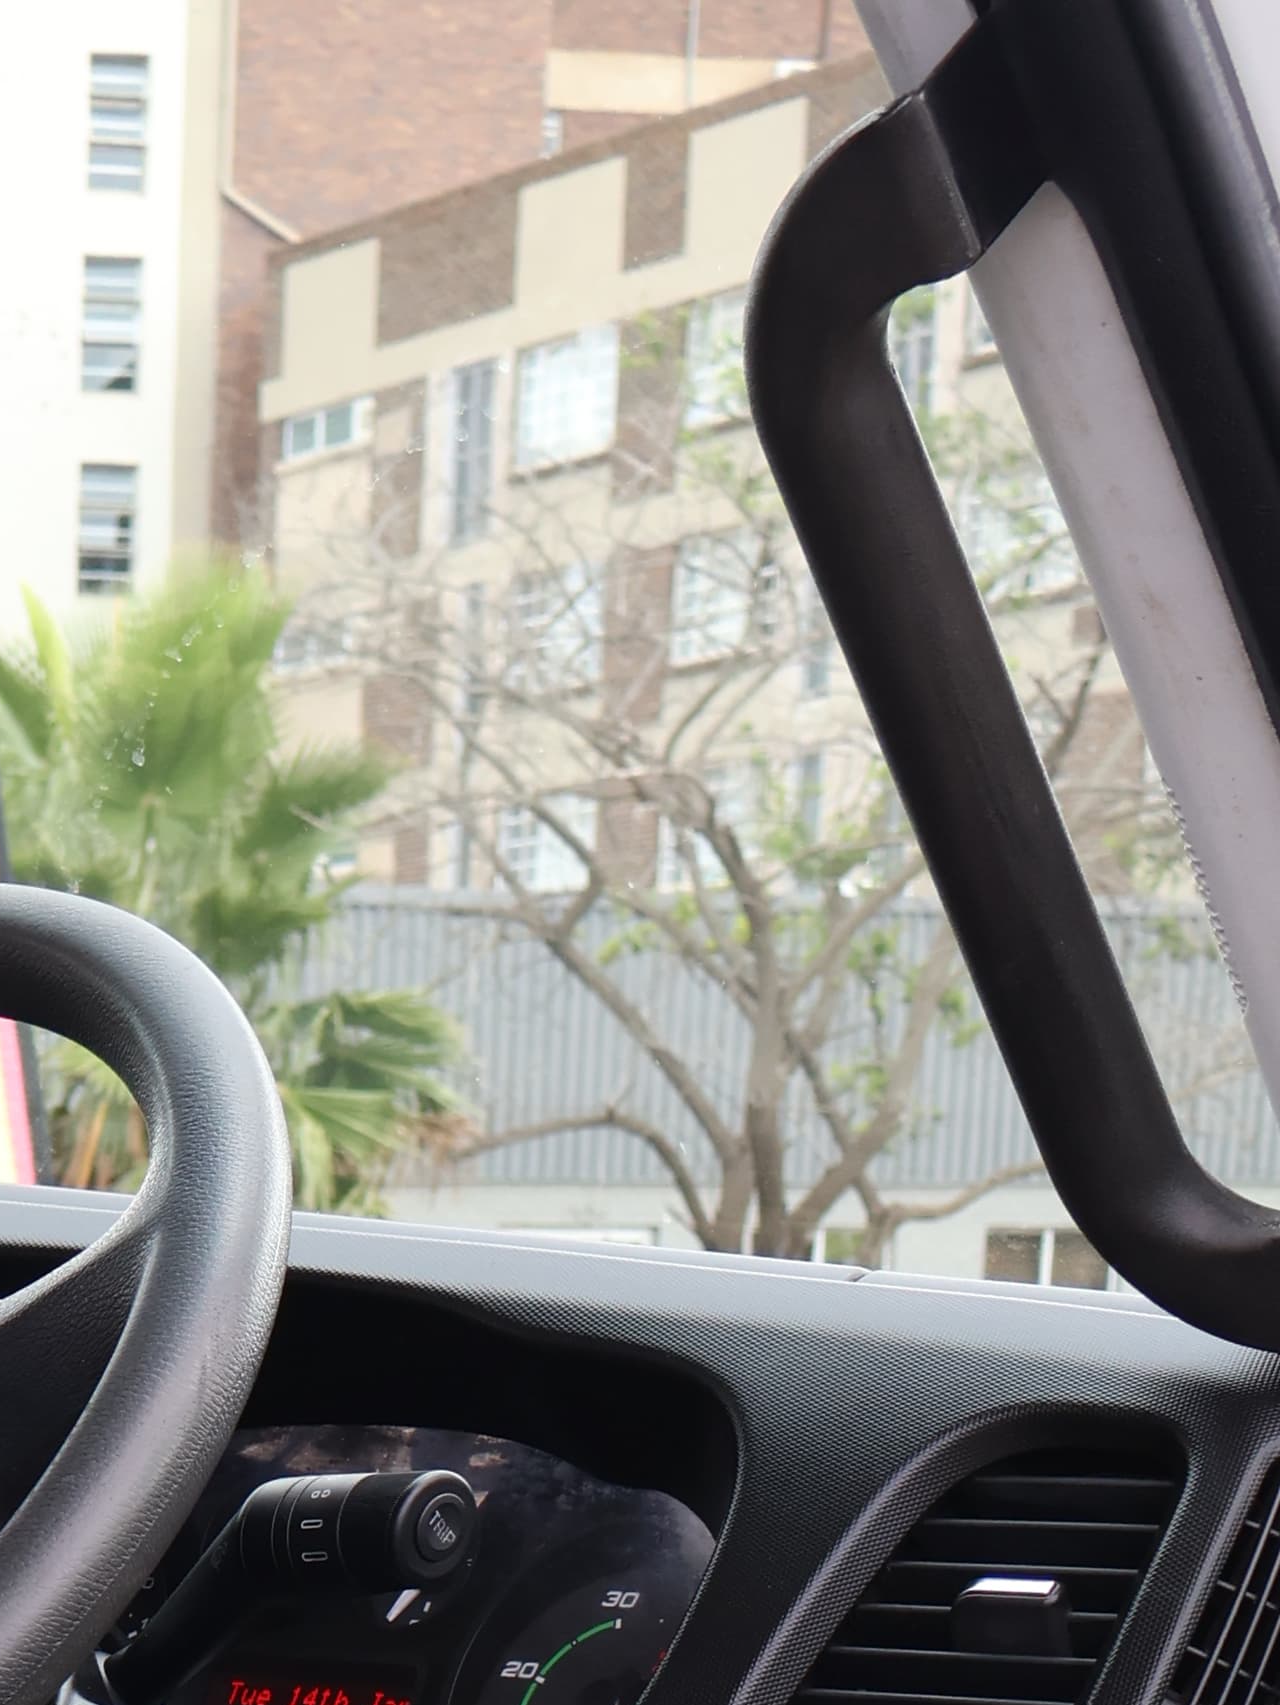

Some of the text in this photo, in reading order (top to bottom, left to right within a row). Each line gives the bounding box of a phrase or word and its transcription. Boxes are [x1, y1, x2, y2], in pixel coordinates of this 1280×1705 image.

[428, 1509, 457, 1544] TRIP
[600, 1590, 640, 1609] 30
[500, 1660, 539, 1679] 20
